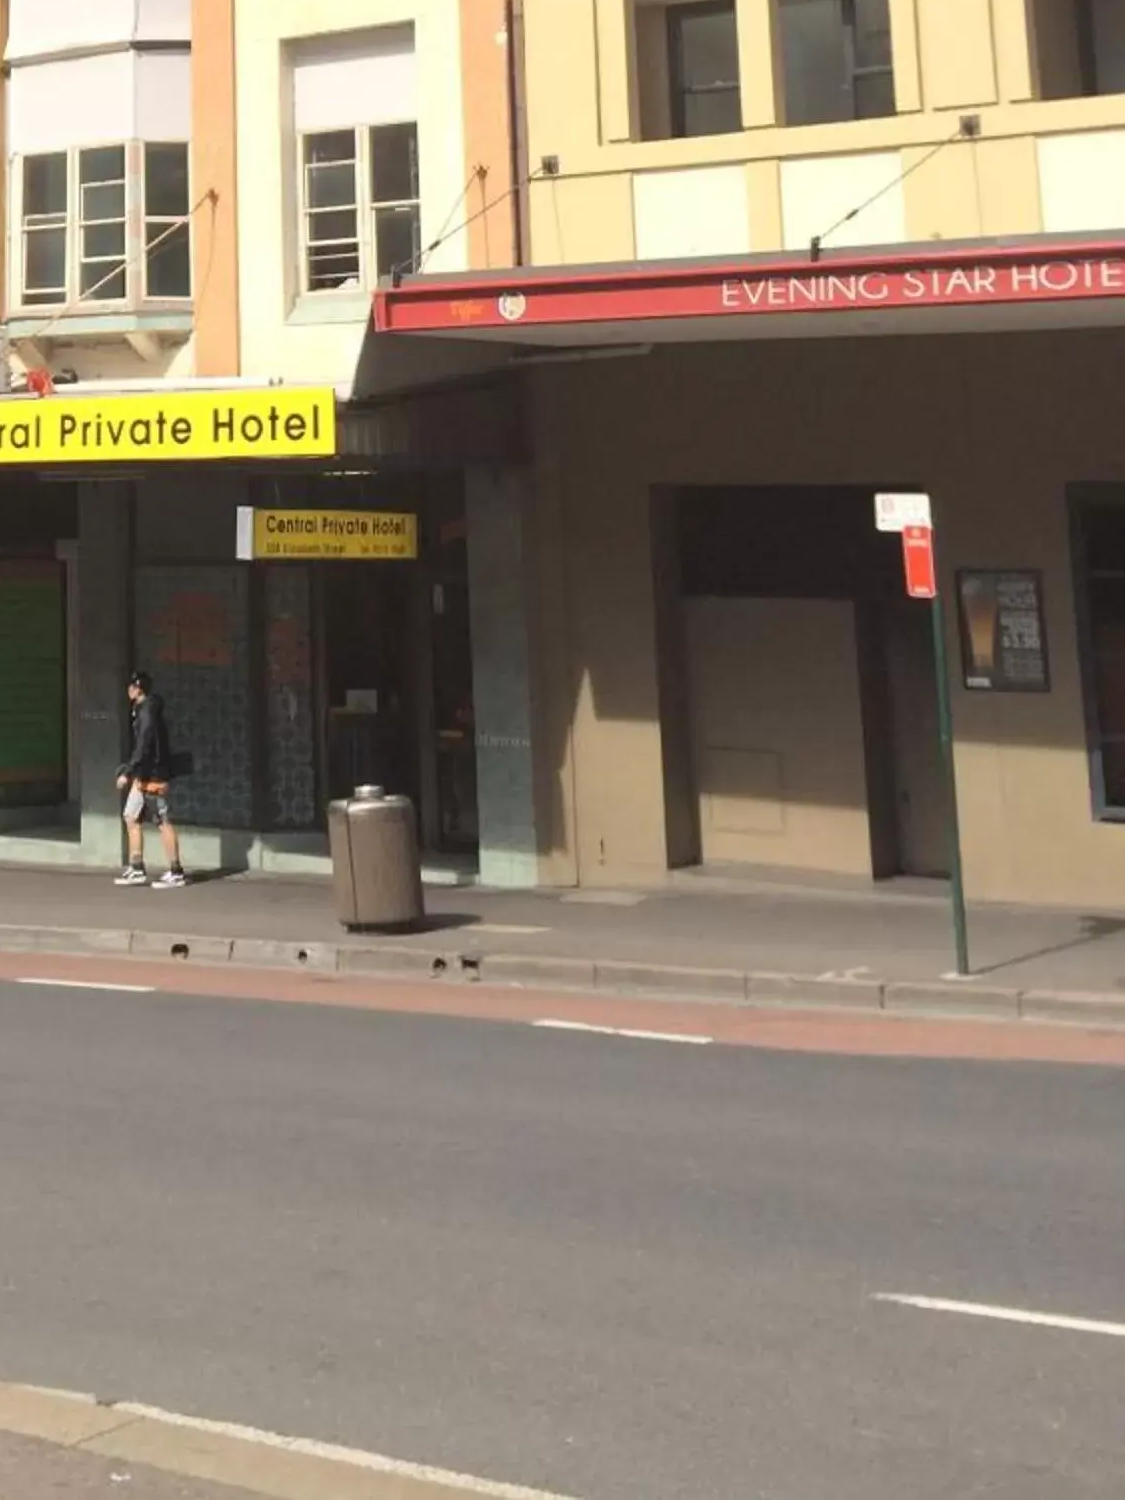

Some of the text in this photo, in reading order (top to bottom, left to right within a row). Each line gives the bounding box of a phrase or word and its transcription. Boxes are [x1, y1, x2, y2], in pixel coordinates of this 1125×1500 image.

[722, 274, 889, 307] EVENING
[902, 267, 996, 299] STAR
[60, 410, 193, 448] Private
[212, 404, 320, 443] Hotel
[266, 515, 406, 536] Central Private Hotel
